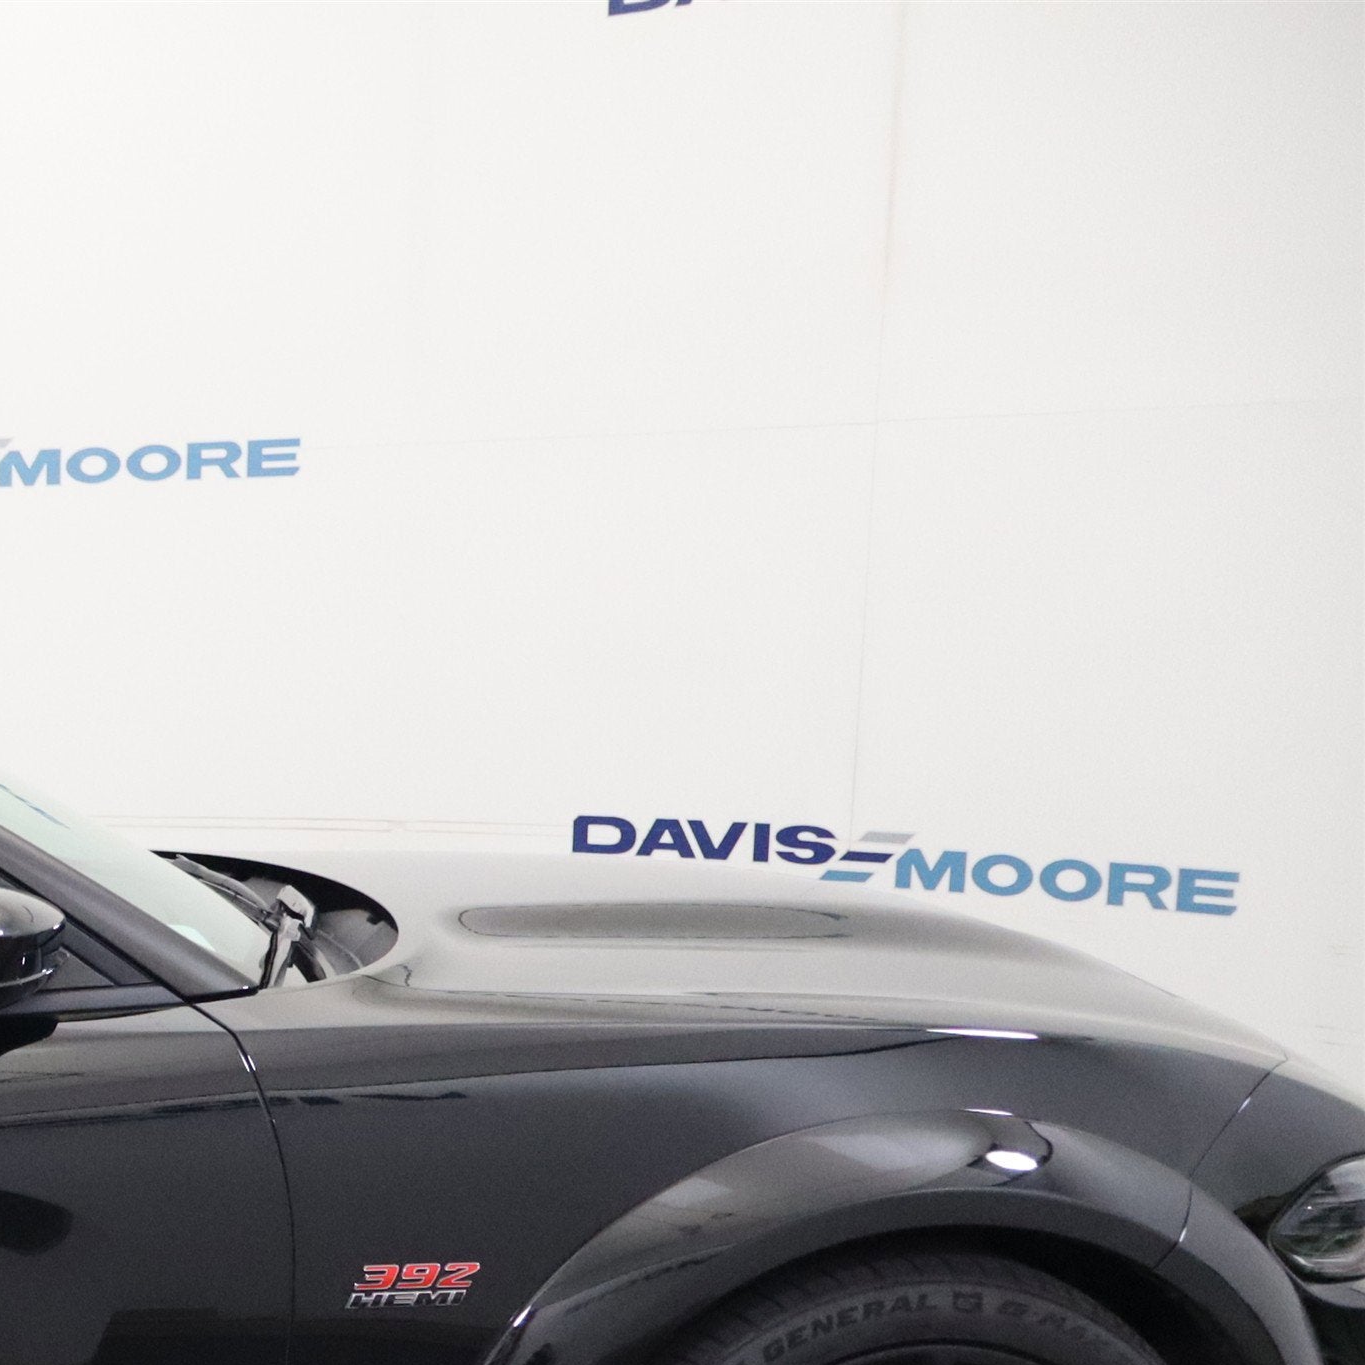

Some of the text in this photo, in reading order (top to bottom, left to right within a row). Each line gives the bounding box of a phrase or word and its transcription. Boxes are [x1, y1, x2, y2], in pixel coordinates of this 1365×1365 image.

[571, 814, 1240, 917] DAVIS MOORE
[345, 1289, 467, 1309] HEMI
[354, 1262, 481, 1291] 392
[762, 1291, 938, 1363] GENERAL
